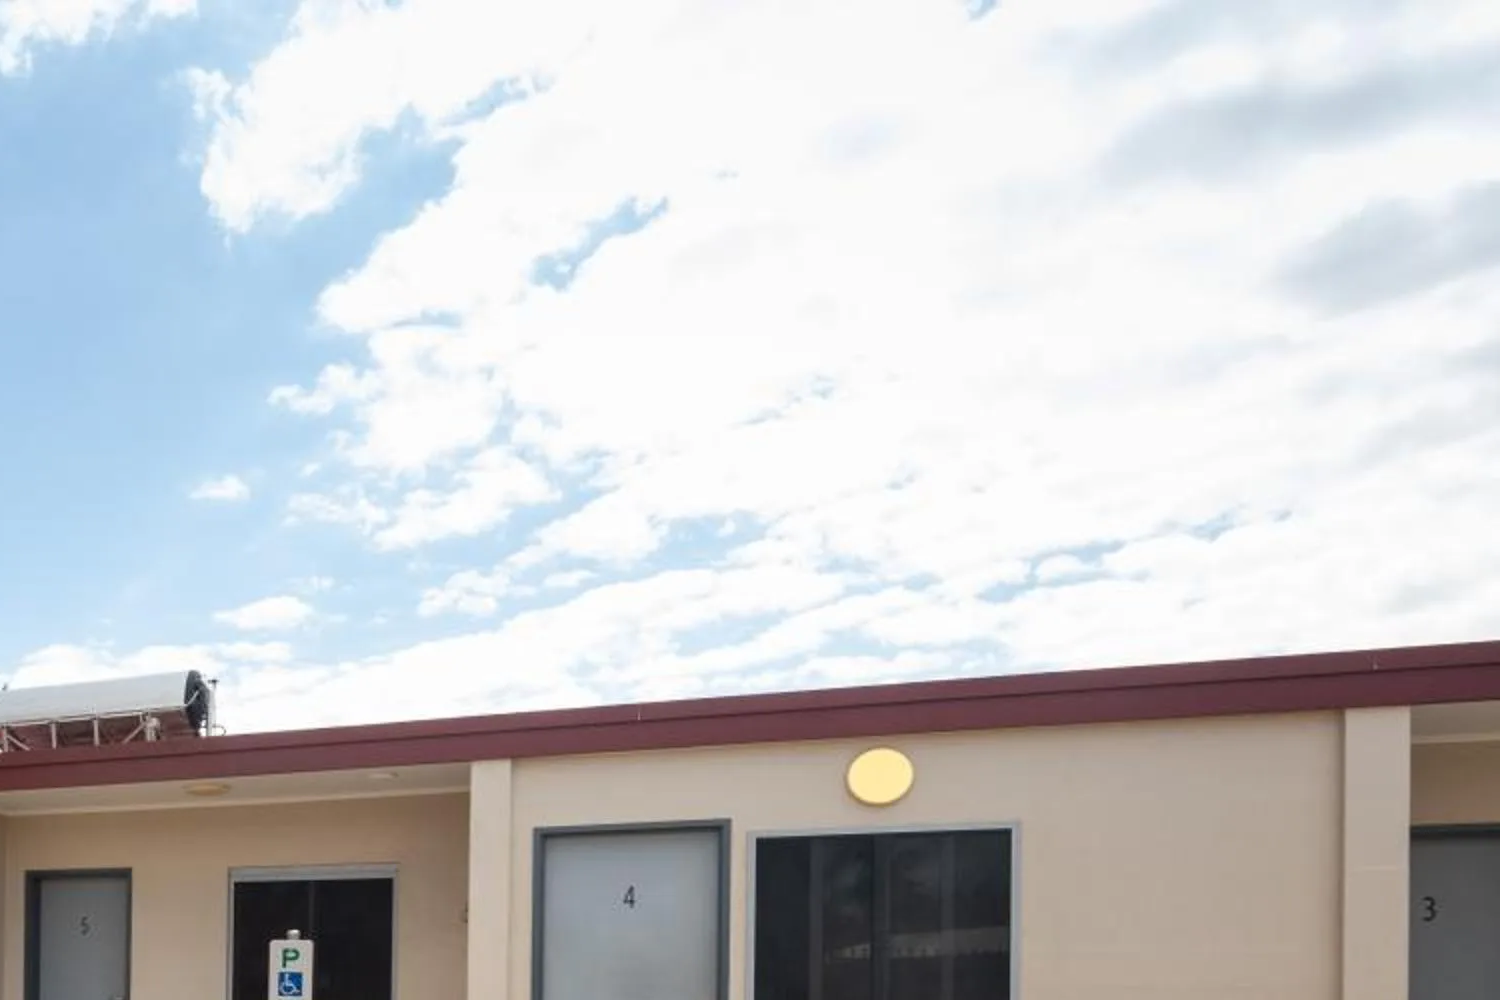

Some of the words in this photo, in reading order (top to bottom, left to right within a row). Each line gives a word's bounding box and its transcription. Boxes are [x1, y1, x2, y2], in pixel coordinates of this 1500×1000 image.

[623, 885, 635, 909] 4
[1423, 896, 1436, 922] 3
[81, 916, 91, 937] 5
[282, 947, 300, 968] P
